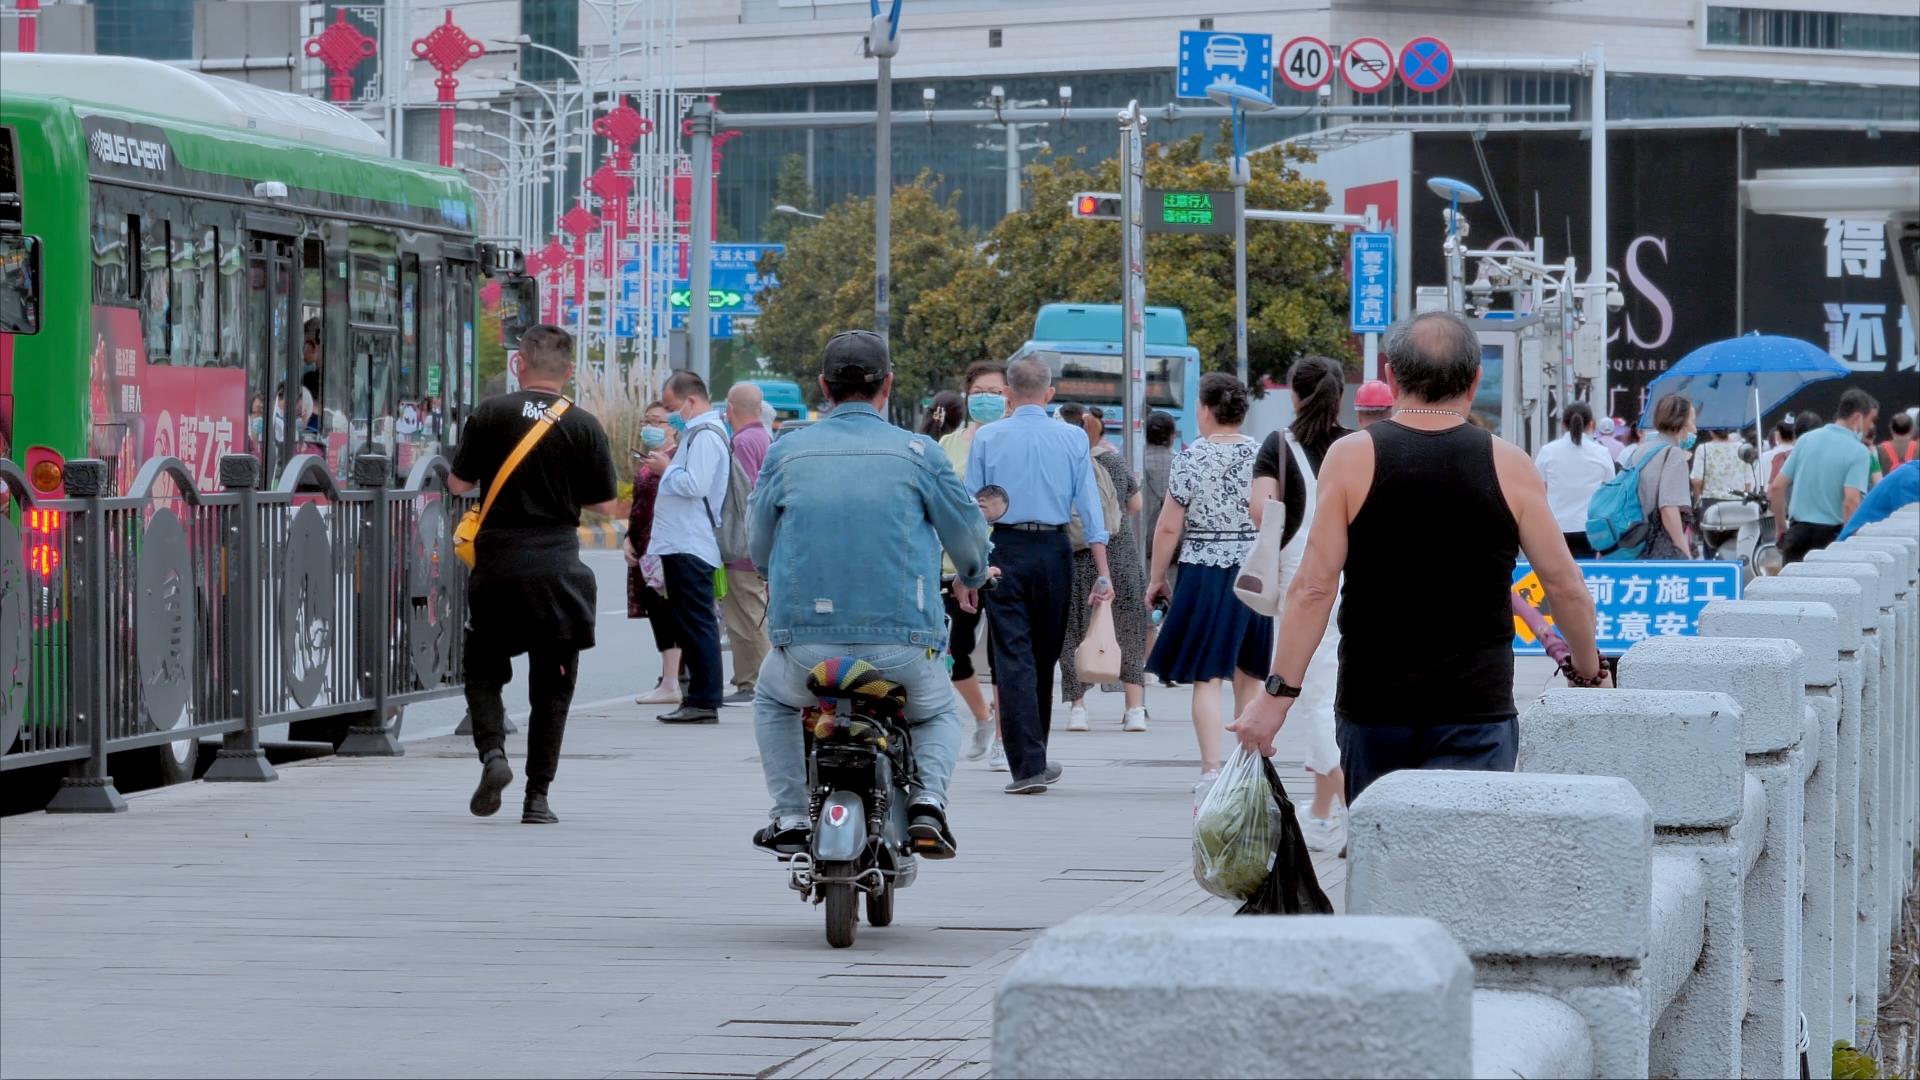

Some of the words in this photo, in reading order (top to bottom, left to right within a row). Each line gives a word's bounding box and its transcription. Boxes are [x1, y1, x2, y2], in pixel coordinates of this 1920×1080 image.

[1290, 48, 1321, 78] 40
[101, 131, 129, 164] BUS
[1585, 575, 1727, 605] 前方施工
[1595, 611, 1700, 641] 注意安
